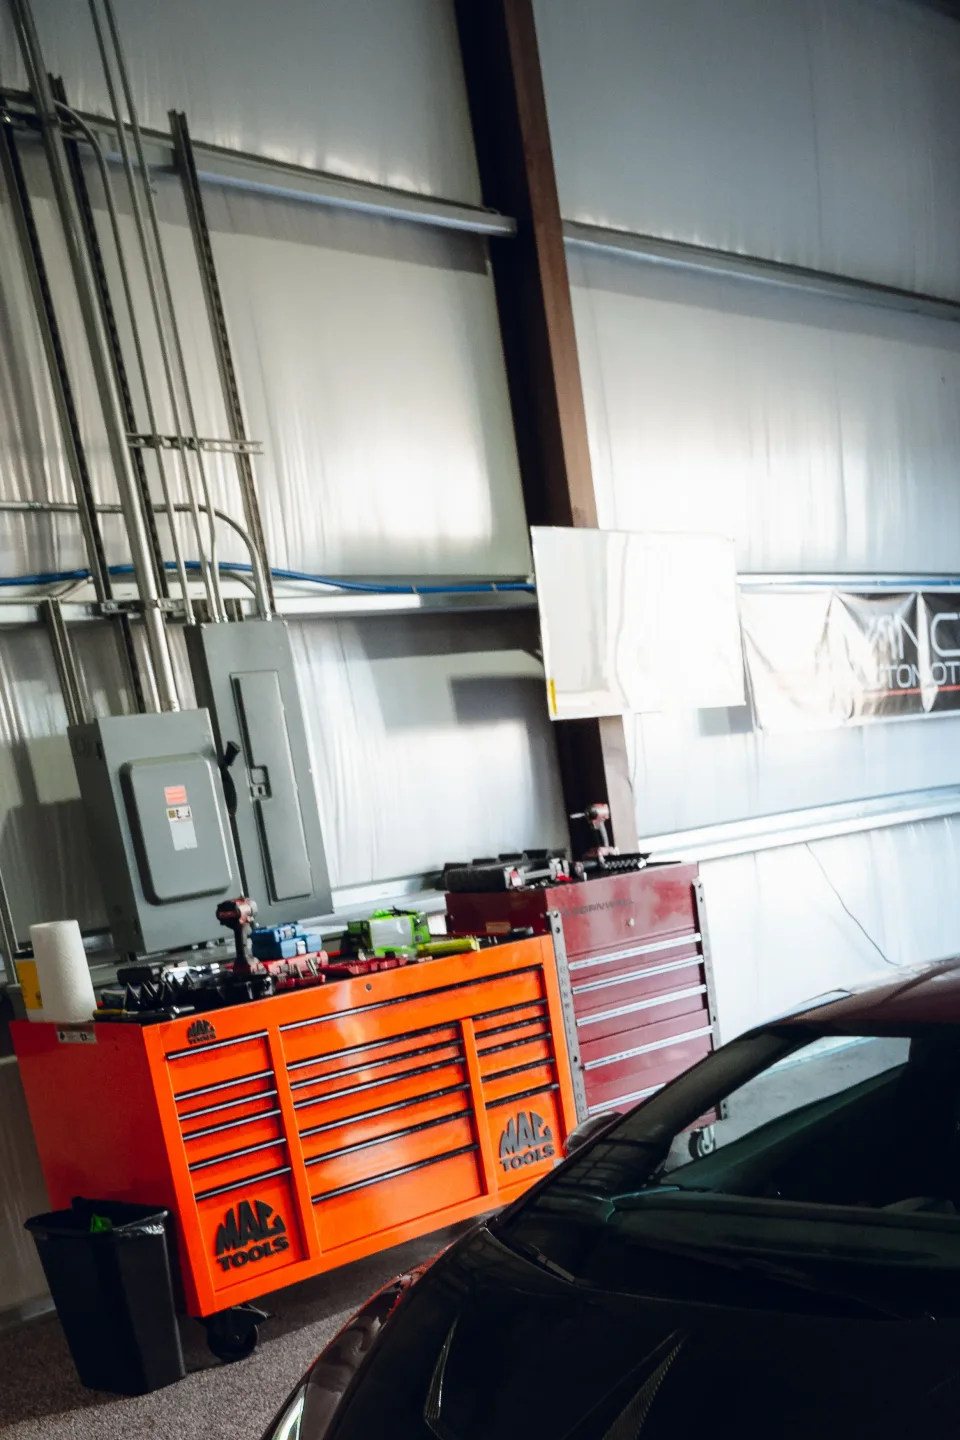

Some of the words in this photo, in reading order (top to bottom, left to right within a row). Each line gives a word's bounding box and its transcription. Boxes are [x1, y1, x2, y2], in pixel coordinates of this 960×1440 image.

[187, 1019, 215, 1037] MAC
[498, 1111, 553, 1158] MAC
[500, 1144, 556, 1172] TOOLS
[215, 1200, 286, 1256] MAC
[216, 1236, 289, 1271] TOOLS
